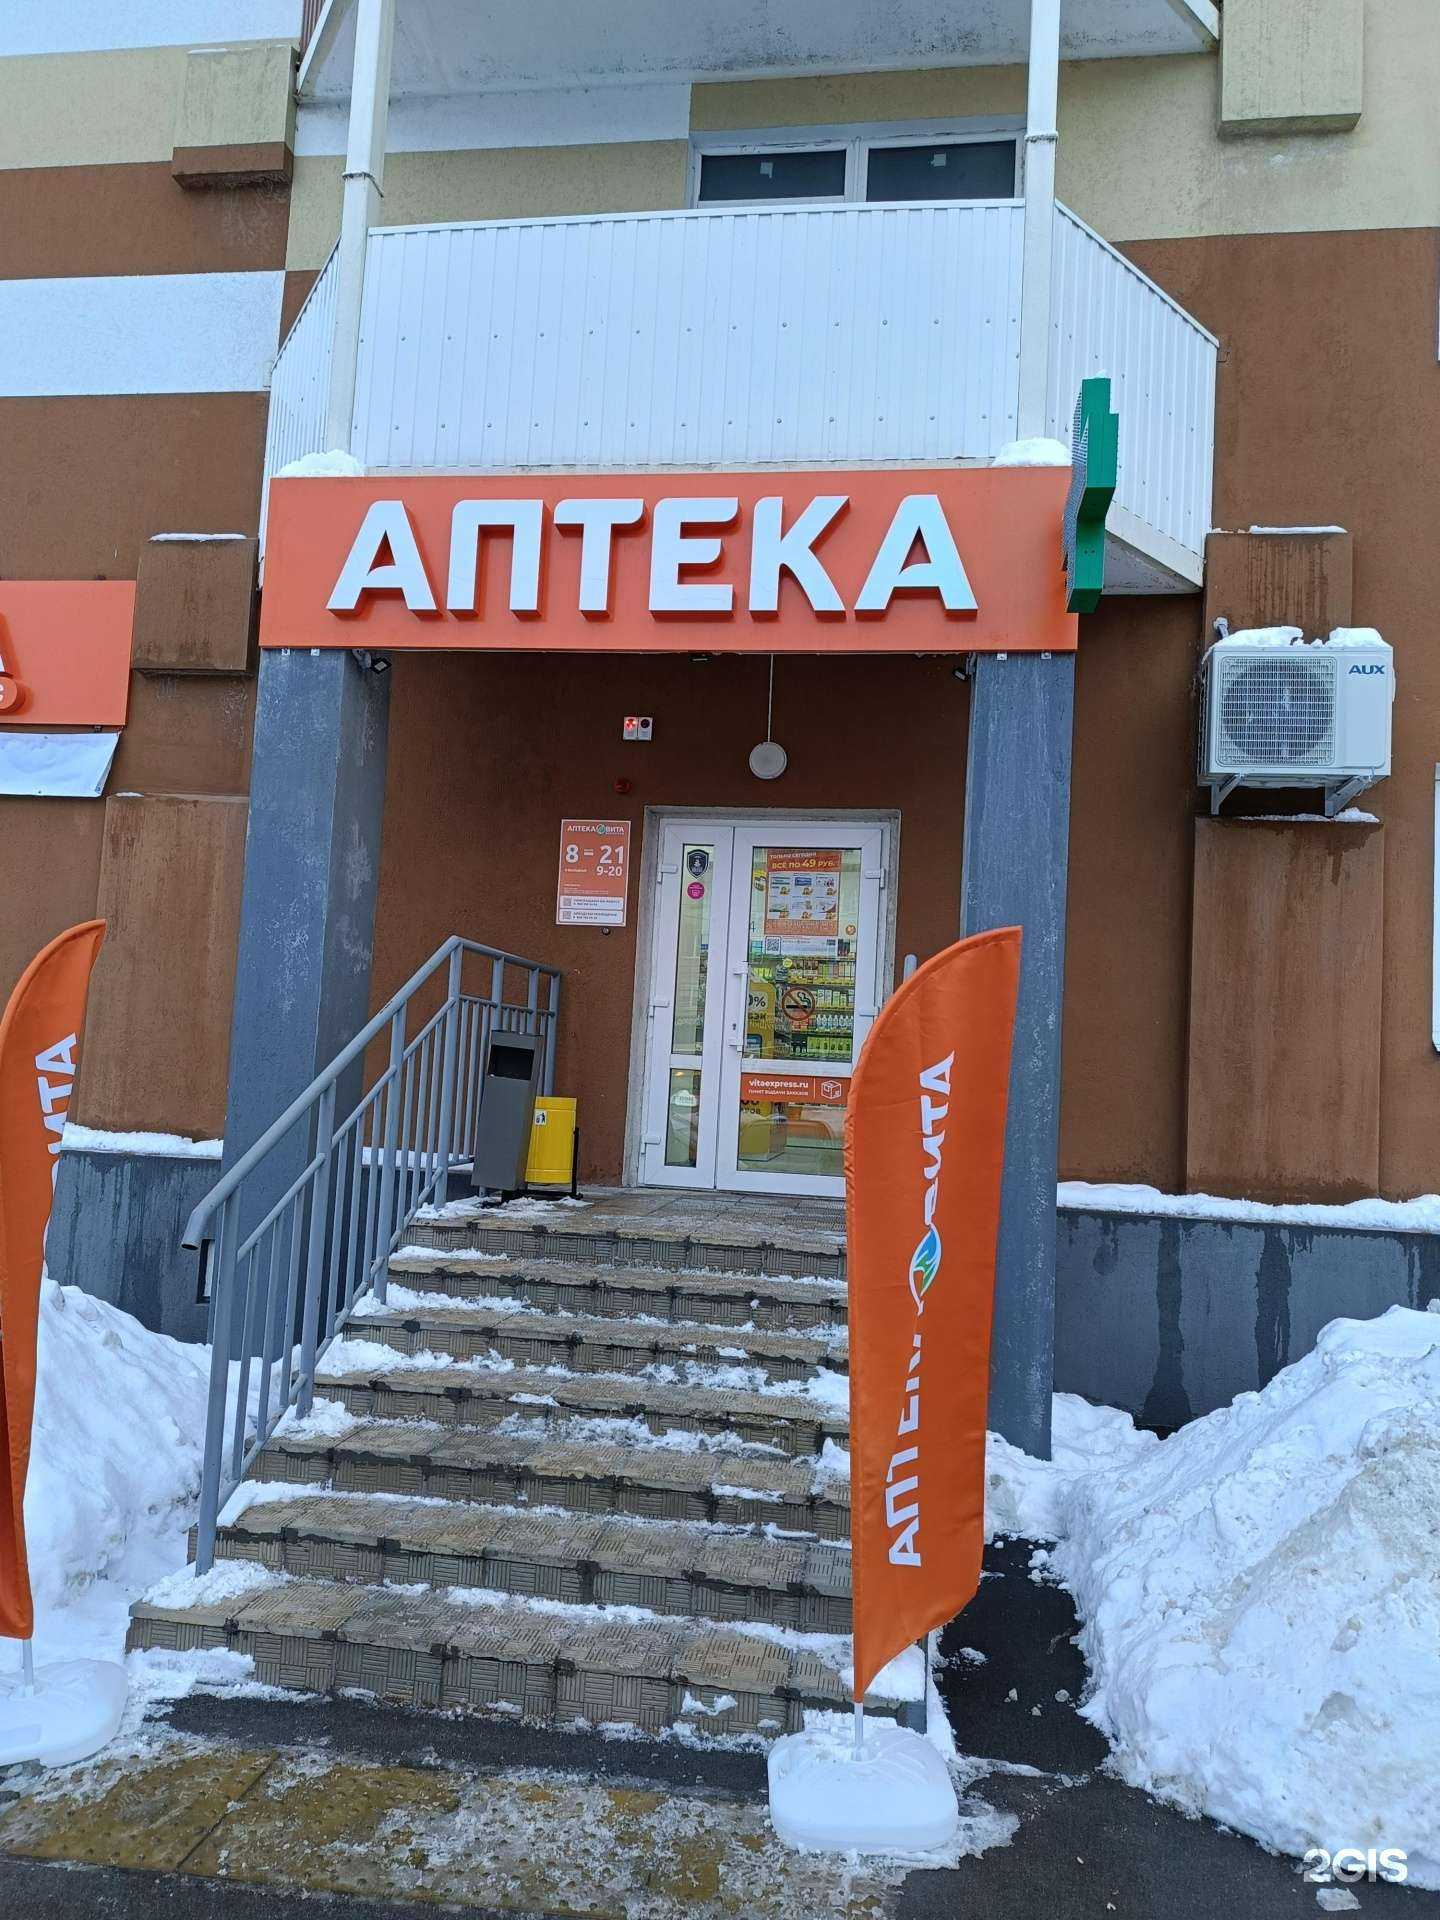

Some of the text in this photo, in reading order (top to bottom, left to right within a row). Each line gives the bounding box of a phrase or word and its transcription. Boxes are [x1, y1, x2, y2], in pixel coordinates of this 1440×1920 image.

[326, 494, 979, 617] АПТЕКА
[1348, 664, 1386, 675] AUX
[567, 825, 596, 833] АПТЕКА
[565, 844, 579, 864] 8
[599, 845, 625, 864] 21
[801, 858, 817, 868] 49
[596, 865, 623, 877] 9-20
[748, 1078, 809, 1089] vitaexpress.ru
[35, 1033, 77, 1197] ИТА
